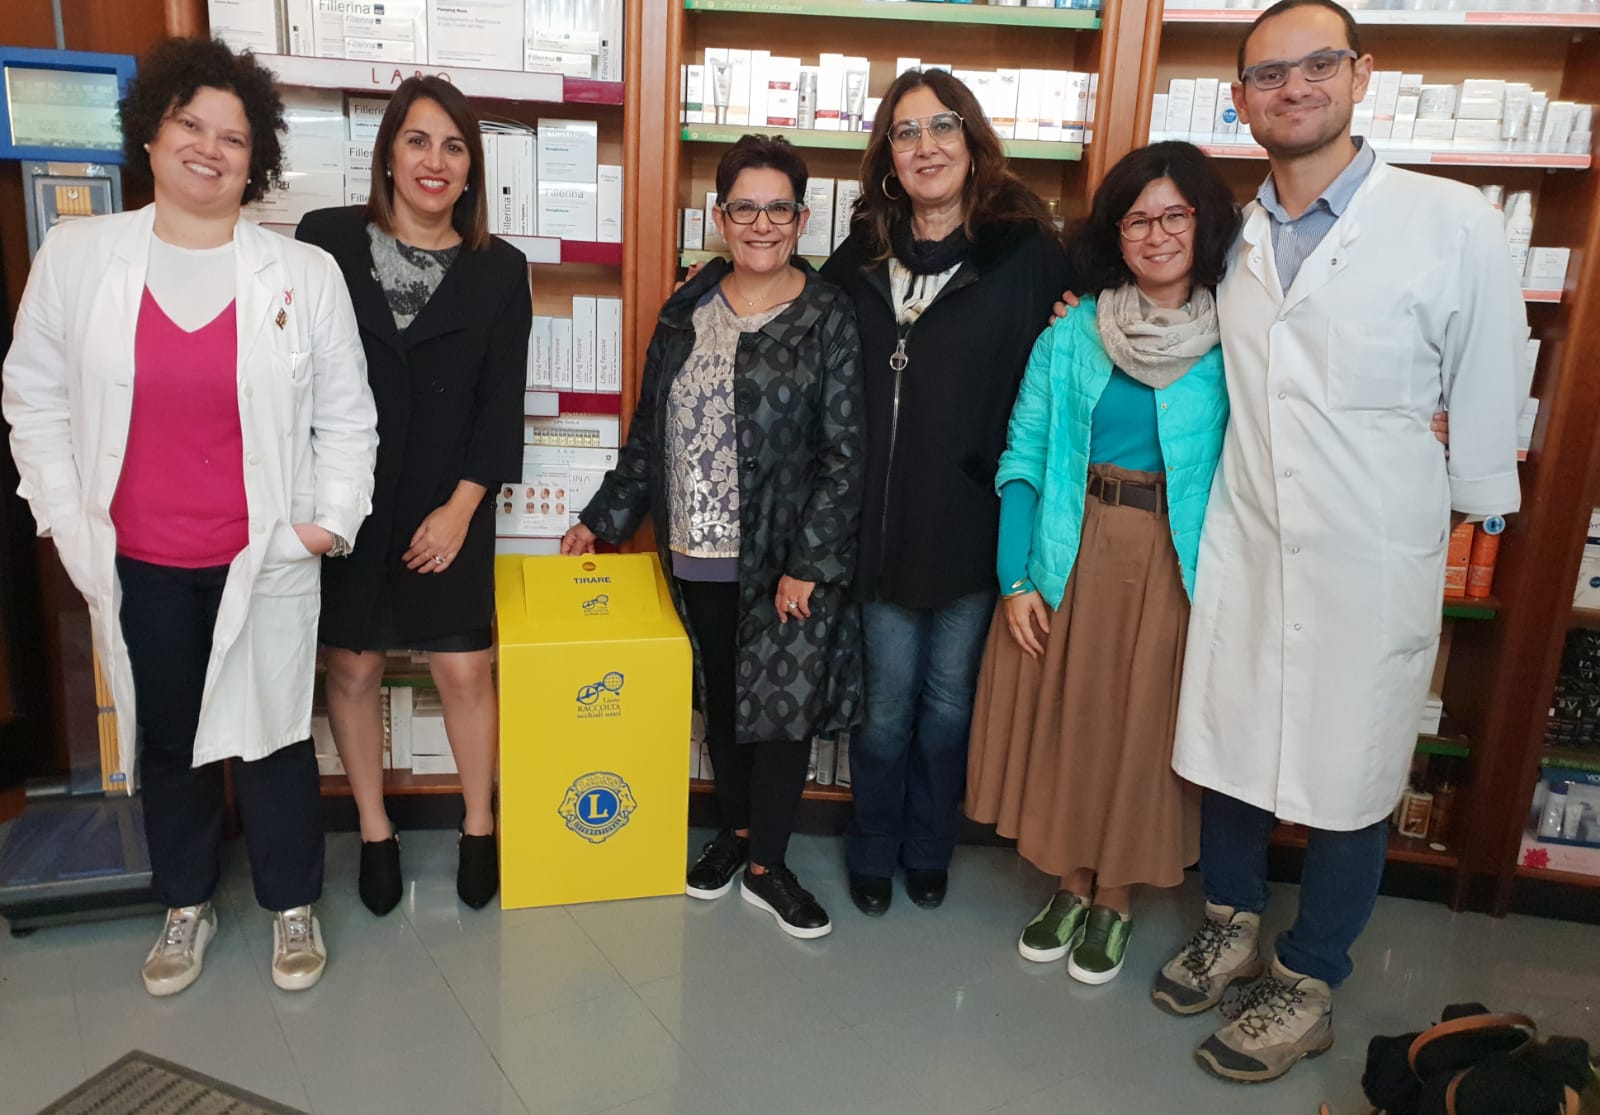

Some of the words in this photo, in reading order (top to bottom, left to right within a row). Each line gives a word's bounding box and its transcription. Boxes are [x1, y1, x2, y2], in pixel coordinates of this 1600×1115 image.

[319, 0, 370, 14] Fillerina
[354, 104, 386, 115] Fillerin
[573, 576, 612, 585] TIRARE
[577, 704, 621, 713] RACCOLTA
[588, 794, 609, 819] L
